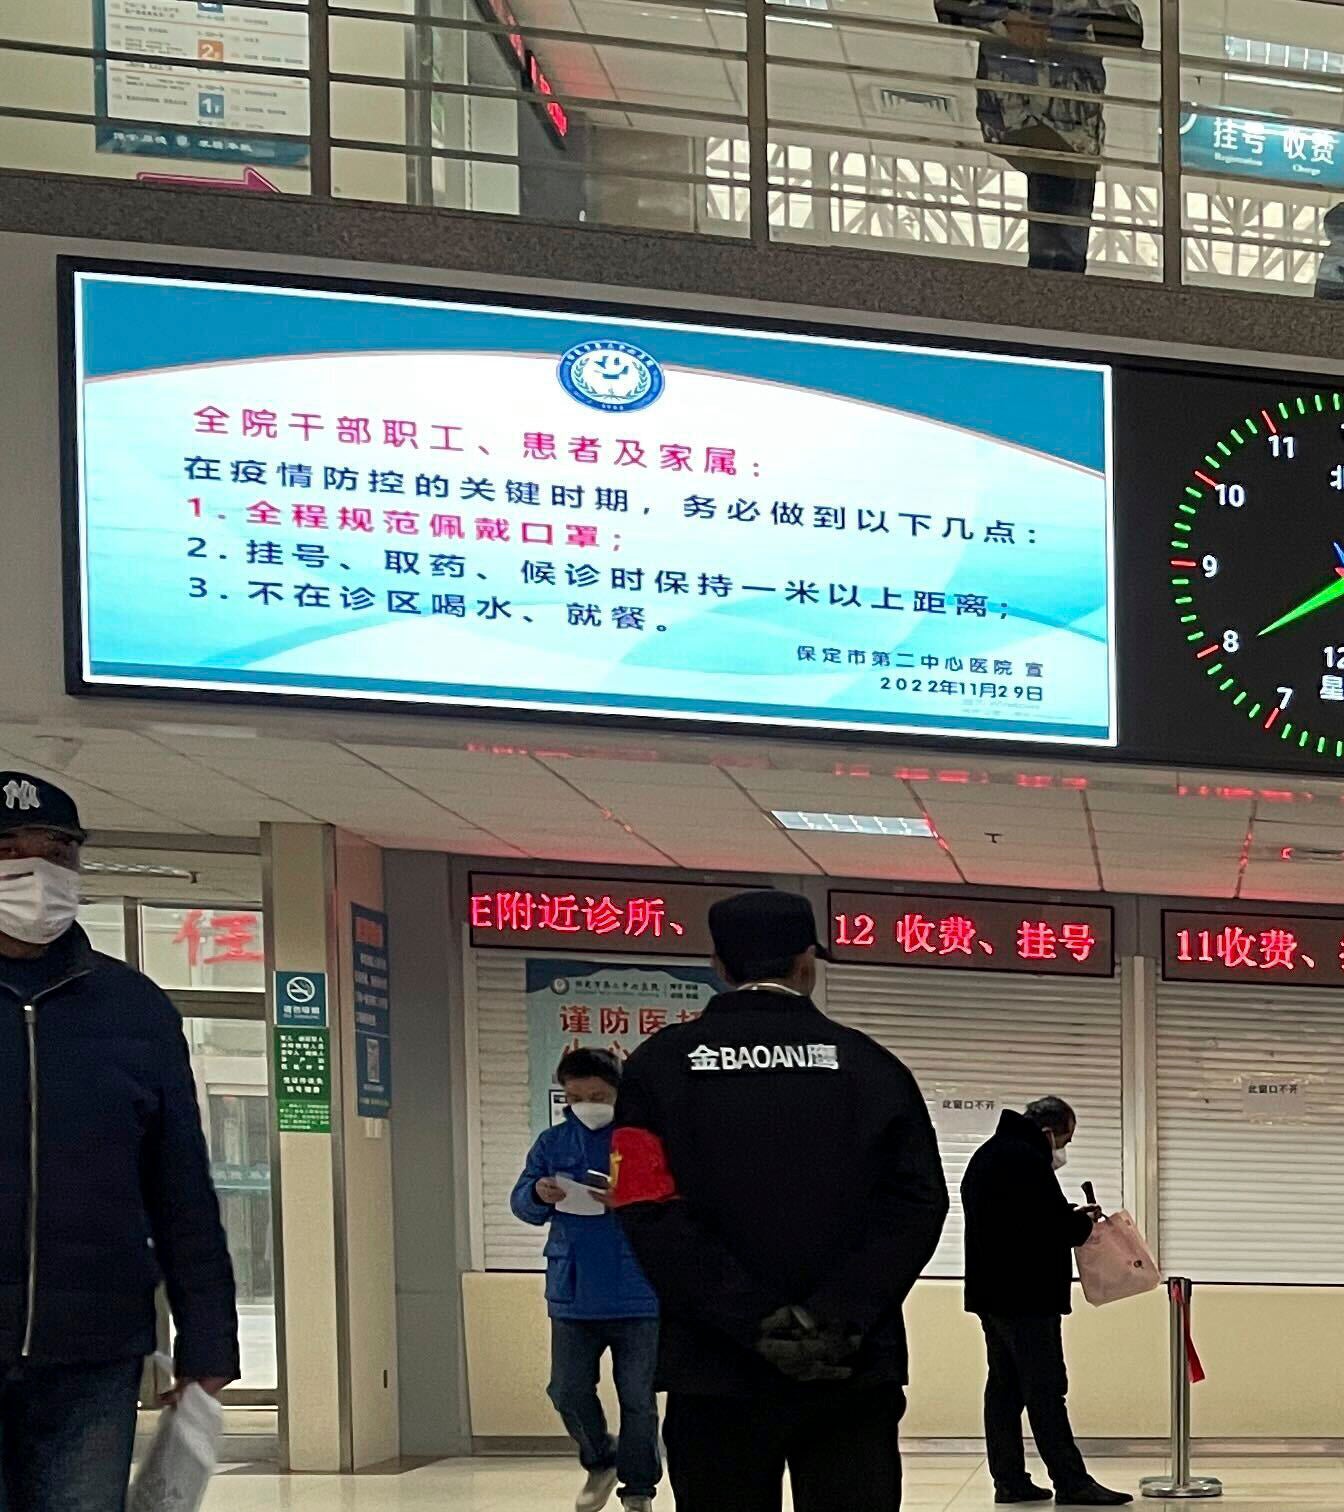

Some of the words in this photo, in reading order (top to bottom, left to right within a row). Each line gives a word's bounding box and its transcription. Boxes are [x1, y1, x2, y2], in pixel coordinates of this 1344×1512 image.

[1213, 116, 1266, 154] 挂号
[1283, 126, 1335, 165] 收费
[193, 405, 761, 478] 全院干部职工、患者及家属：
[1268, 435, 1295, 459] 11
[1214, 484, 1246, 508] 10
[1202, 555, 1218, 578] 9
[1223, 630, 1239, 653] 8
[797, 644, 1012, 676] 保定市第二中心医院
[1025, 662, 1043, 677] 宣
[880, 676, 1043, 701] 2022年11月29日
[1276, 687, 1293, 710] 7
[833, 914, 876, 946] 12
